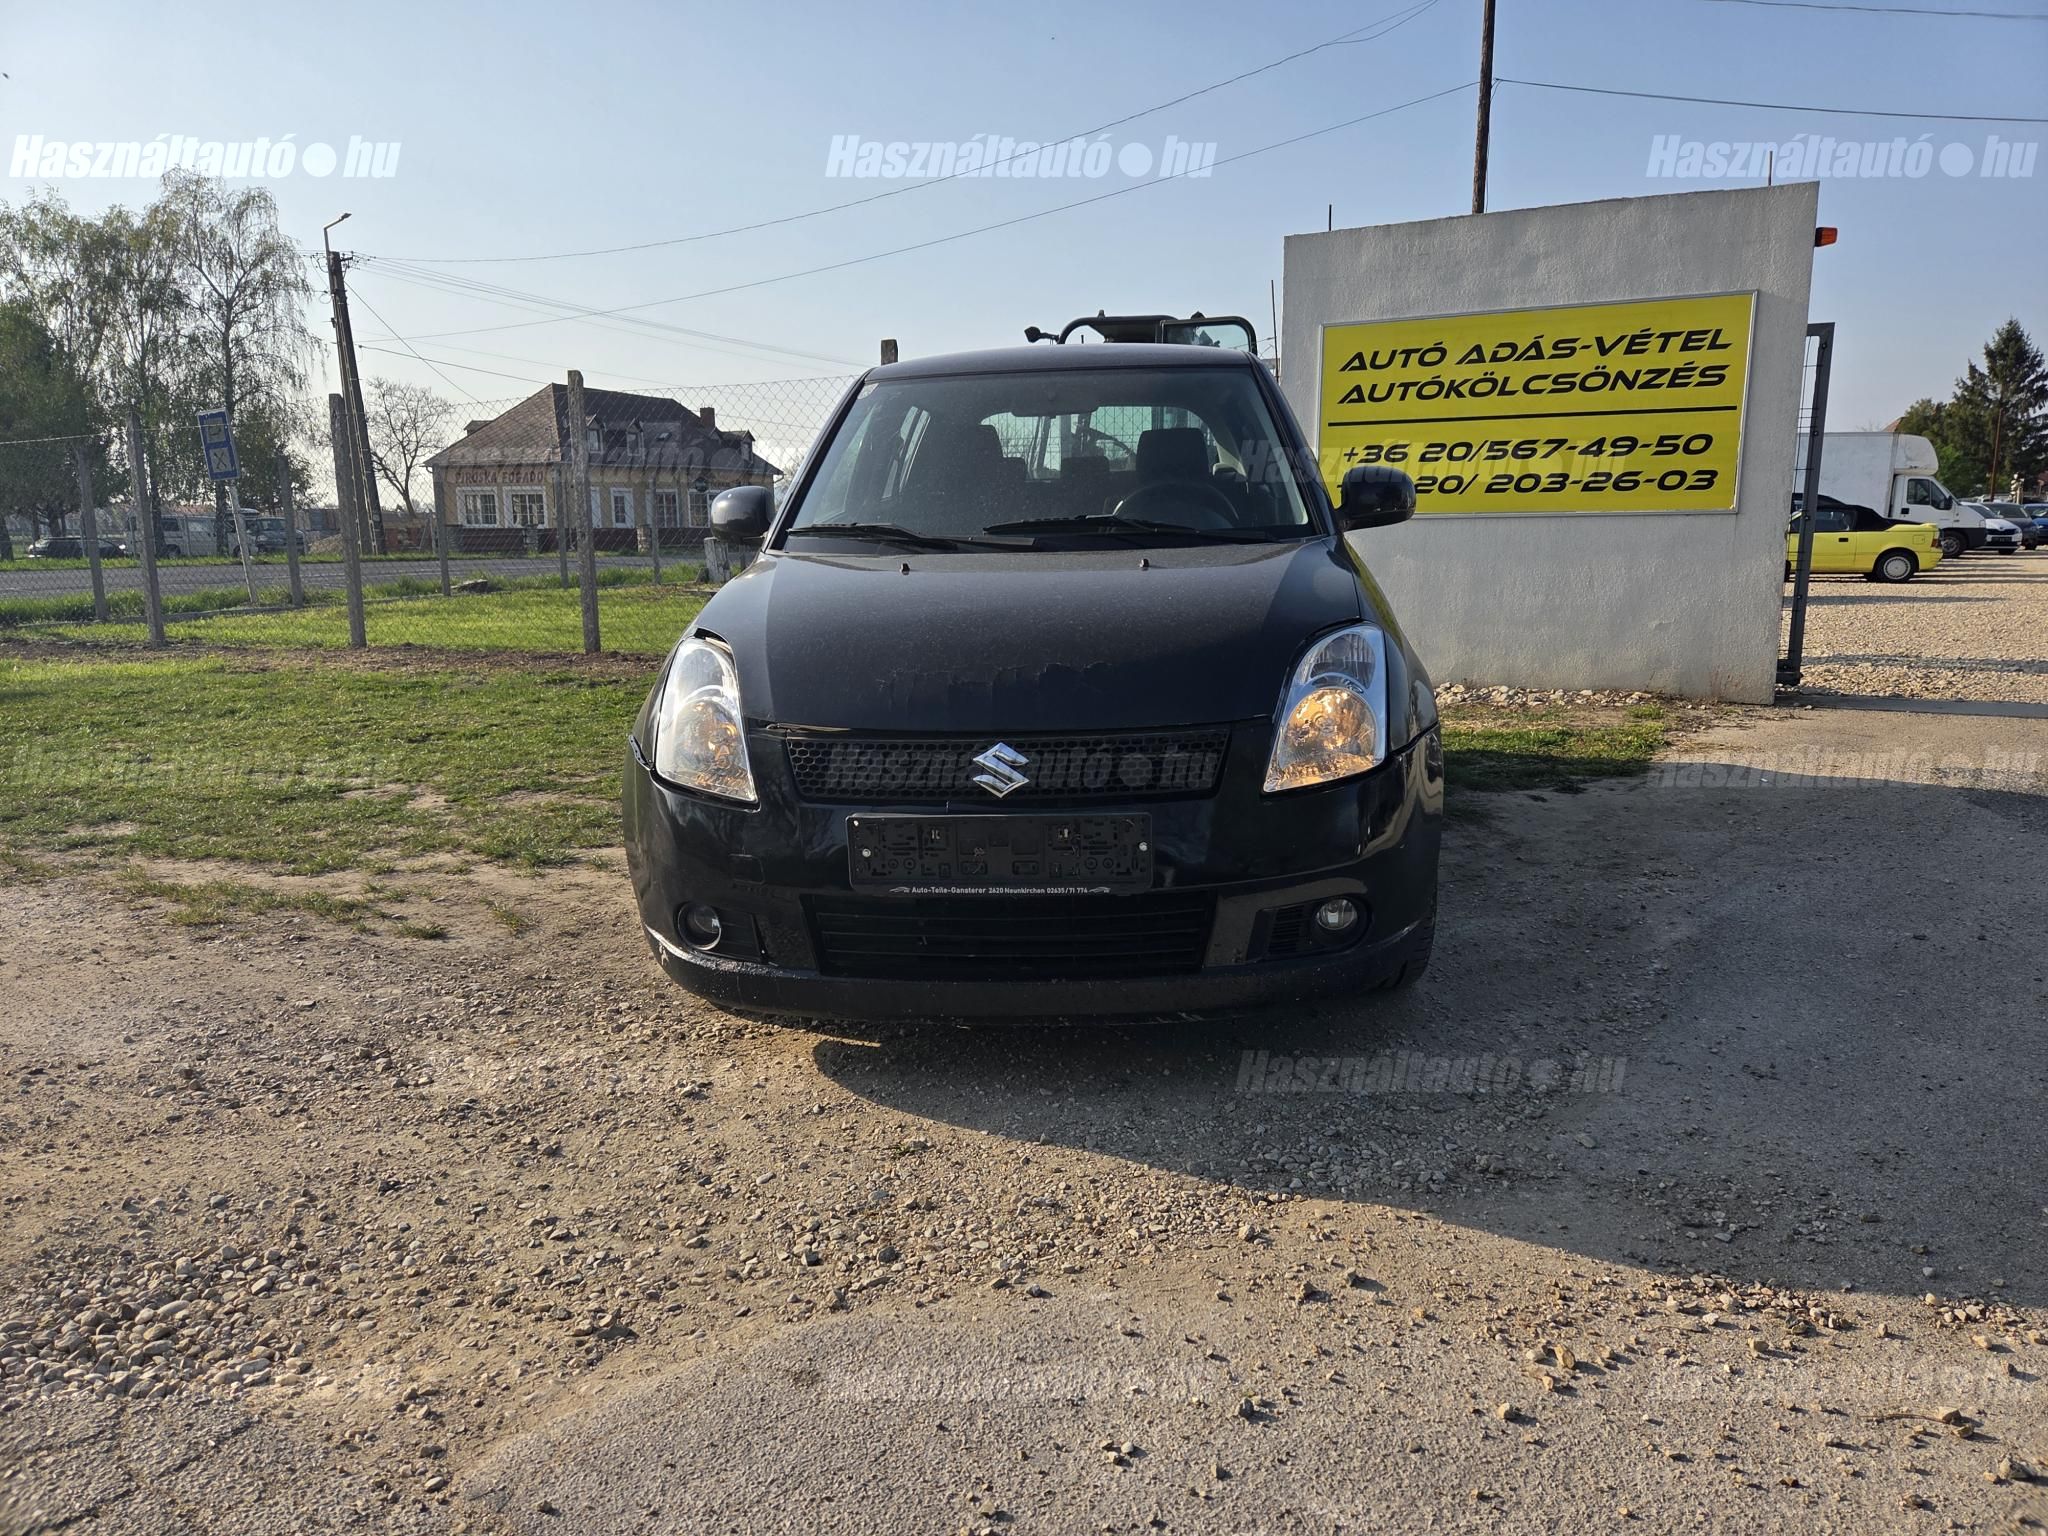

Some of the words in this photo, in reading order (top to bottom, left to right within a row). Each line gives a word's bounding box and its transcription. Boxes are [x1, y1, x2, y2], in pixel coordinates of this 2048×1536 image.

[1338, 341, 1448, 373] AUTÓ
[1455, 328, 1733, 366] ADÁS-VÉTEL
[1337, 360, 1731, 405] AUTÓKÖLCSÖNZÉS
[1343, 443, 1411, 464] +36
[1418, 433, 1714, 463] 20/567-49-50
[1484, 469, 1719, 494] 203-26-03
